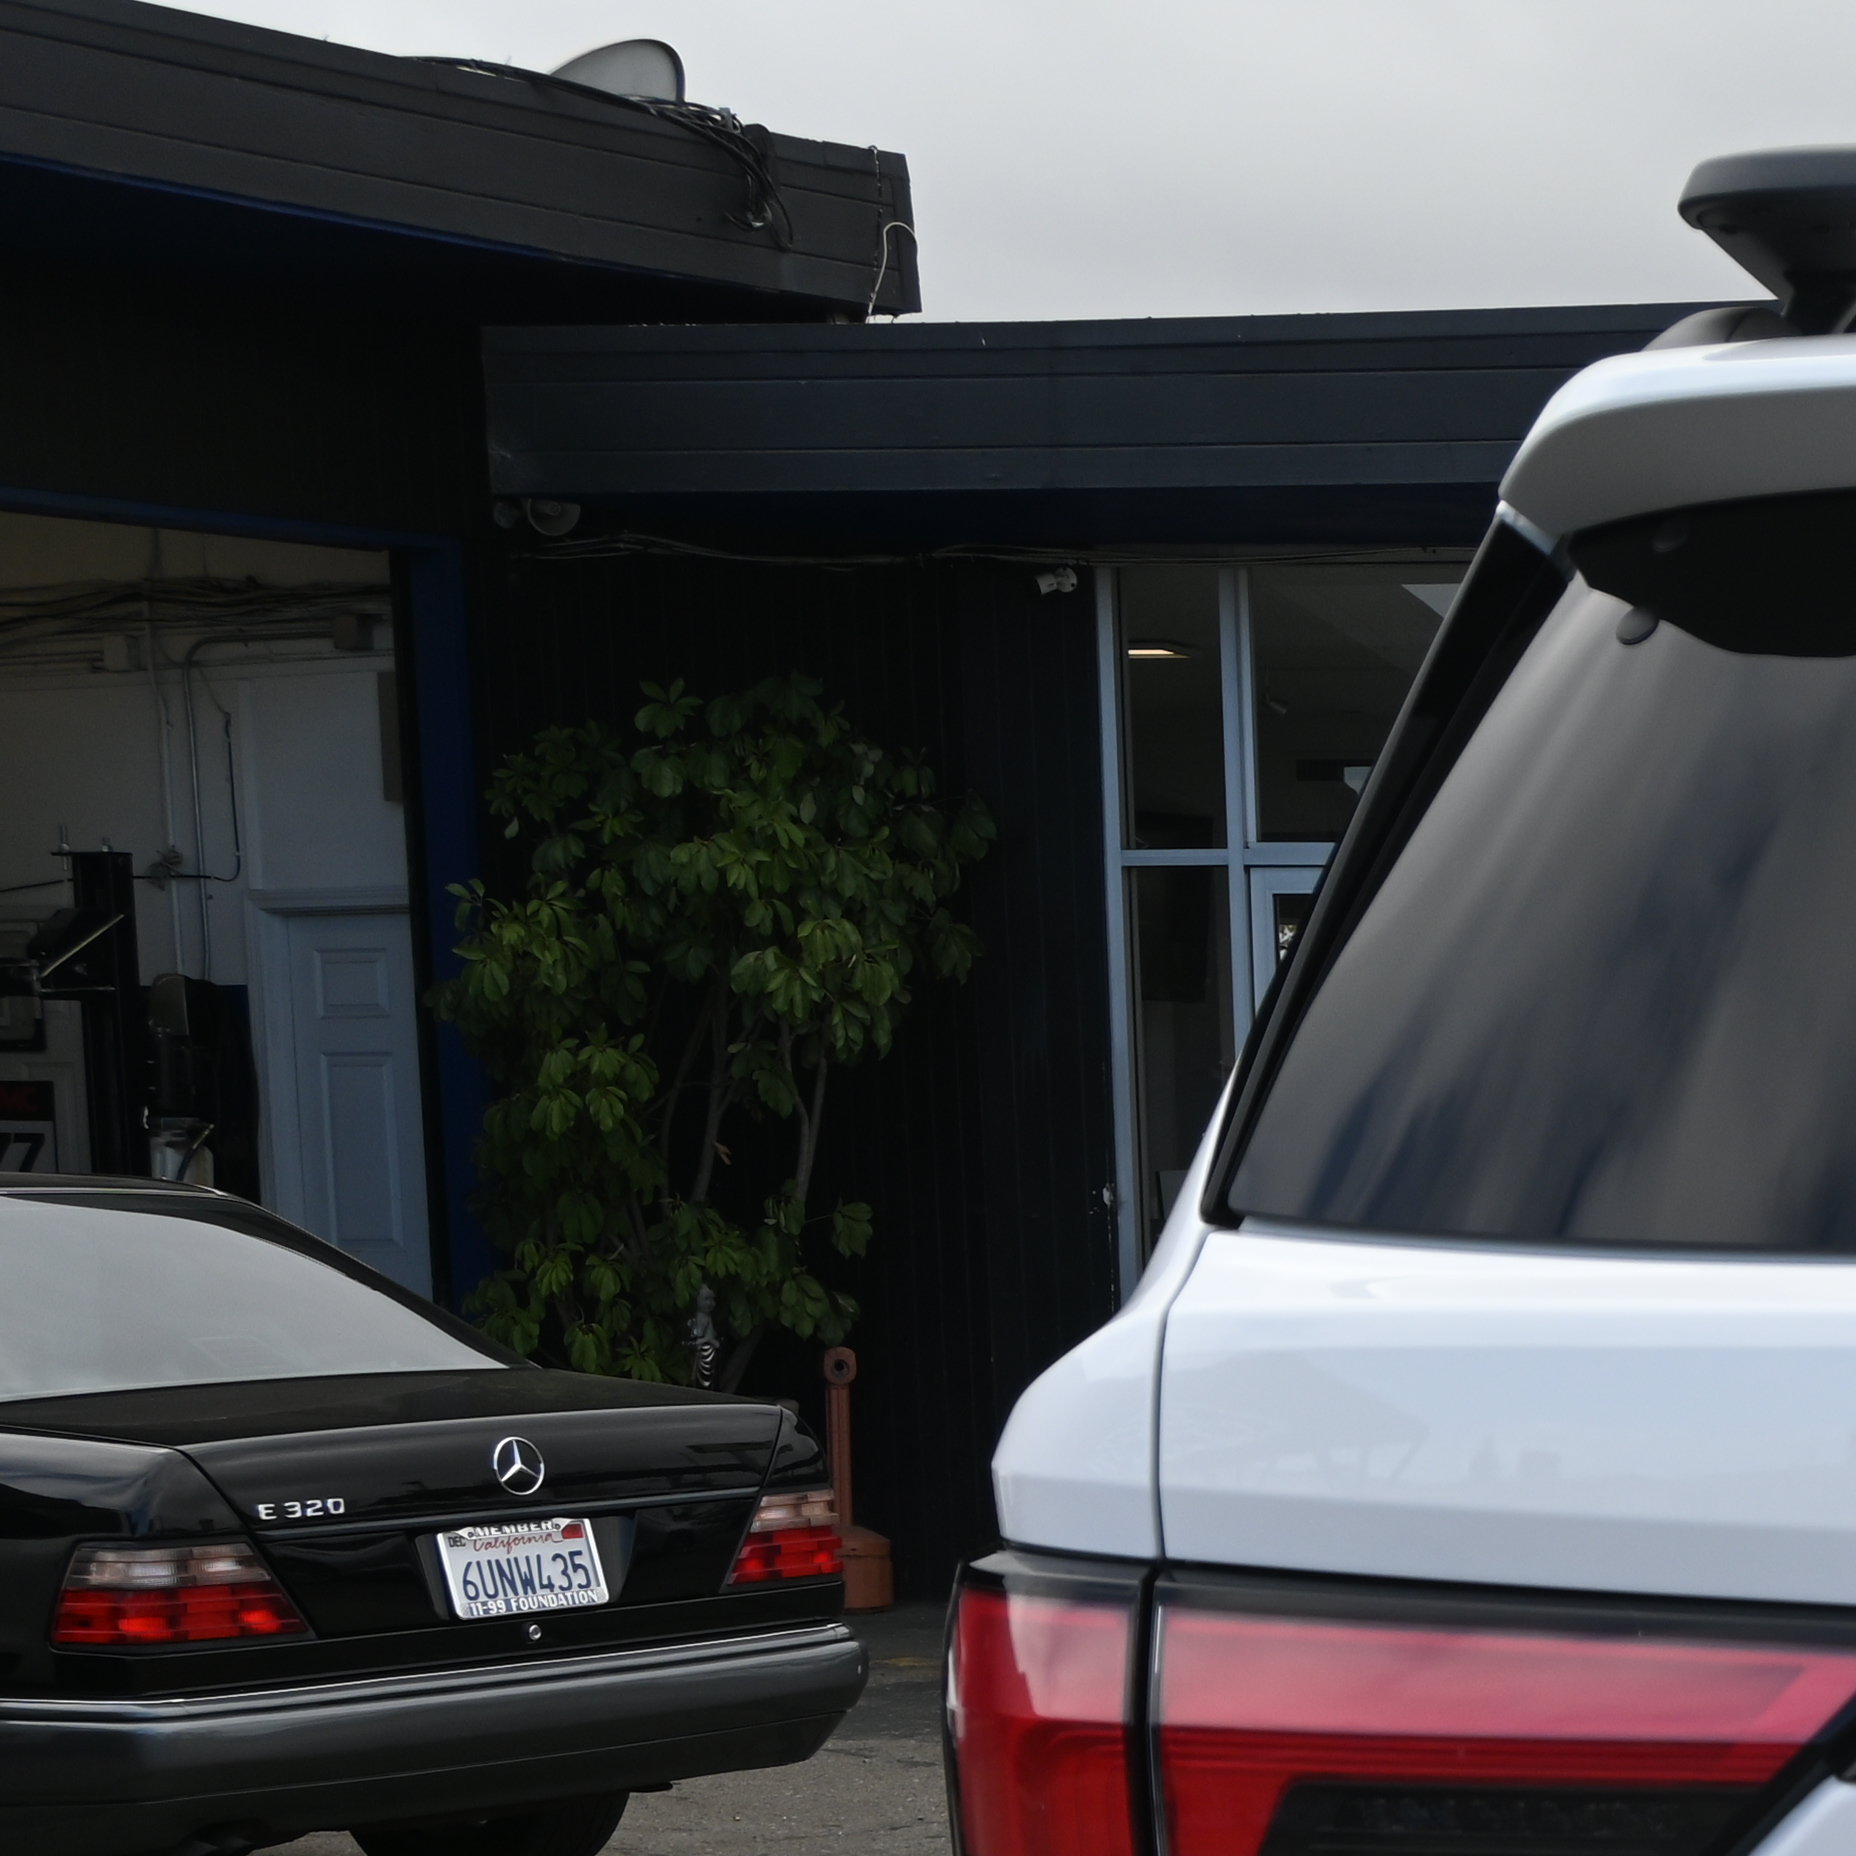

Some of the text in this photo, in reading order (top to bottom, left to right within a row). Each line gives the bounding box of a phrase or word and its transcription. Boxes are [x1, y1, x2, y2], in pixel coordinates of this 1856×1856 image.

[283, 1498, 345, 1518] 320
[475, 1521, 551, 1537] MEMBER
[448, 1536, 466, 1548] DEC
[473, 1532, 563, 1555] California
[462, 1550, 592, 1602] 6UNW435
[470, 1589, 599, 1617] 11-99 FOUNDATION
